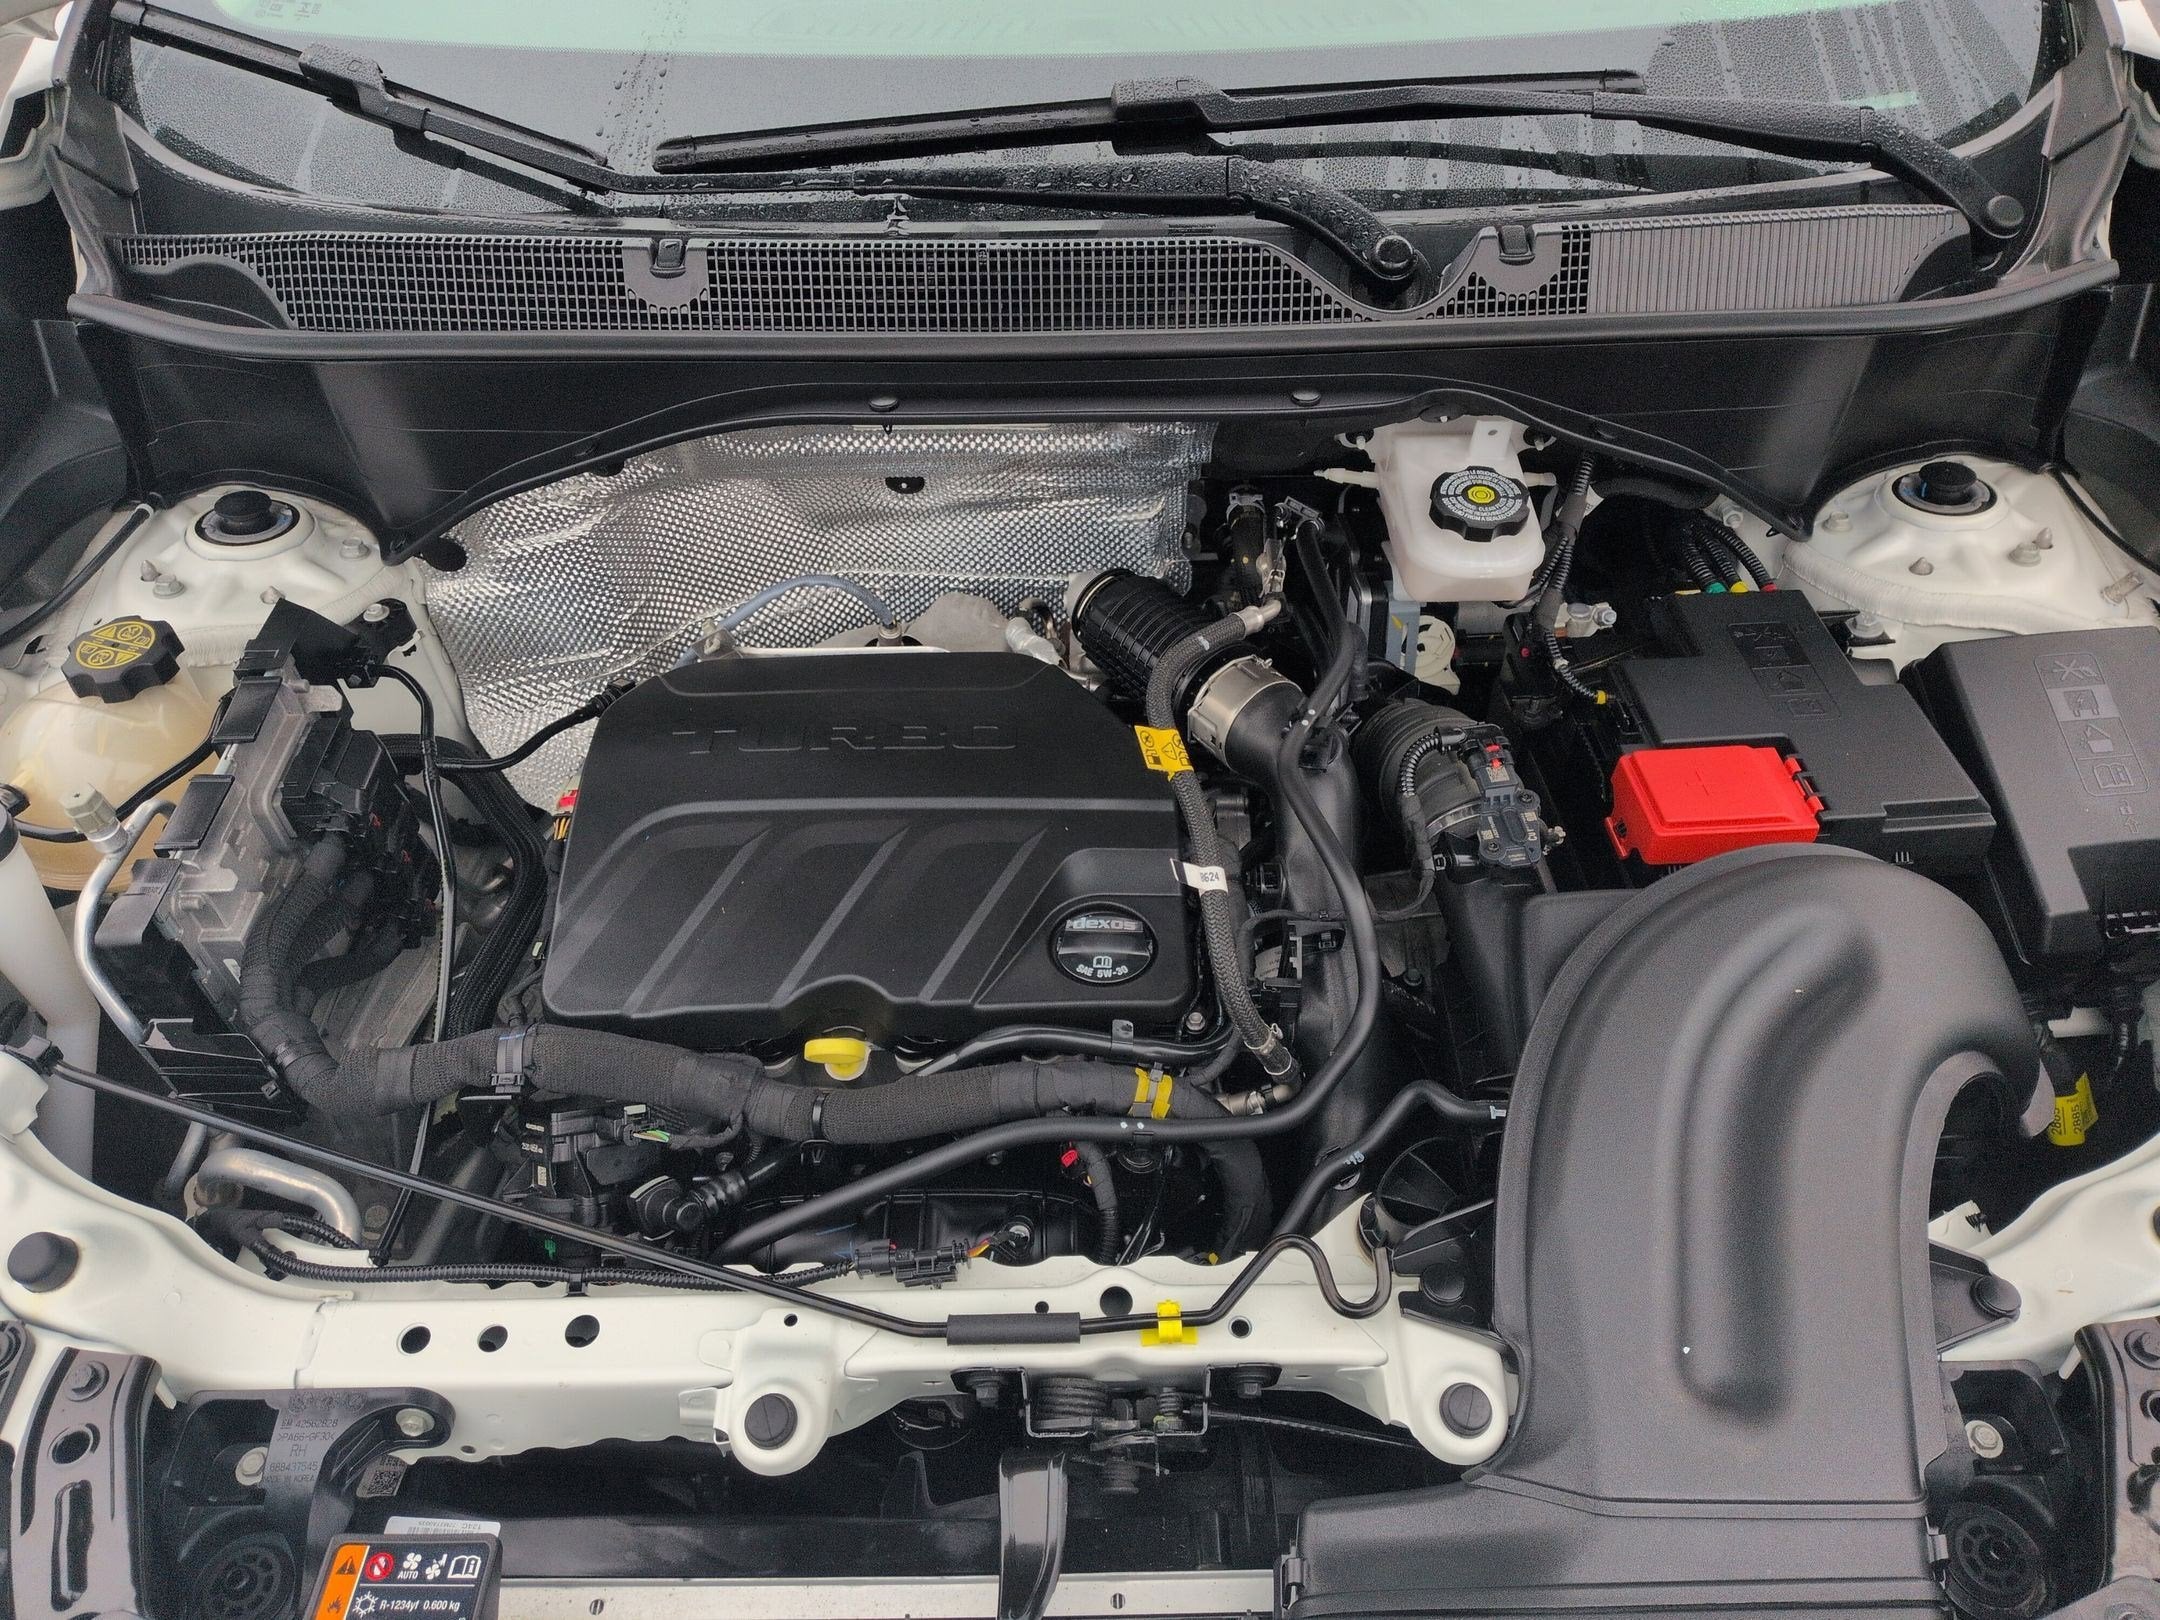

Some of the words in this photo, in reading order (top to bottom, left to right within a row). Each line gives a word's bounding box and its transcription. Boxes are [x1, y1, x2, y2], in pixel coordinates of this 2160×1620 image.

[672, 725, 1016, 755] TURBO
[1072, 917, 1137, 931] dexos
[1076, 964, 1094, 977] SAE
[1096, 964, 1129, 978] 5W-30
[290, 1443, 308, 1457] RH
[397, 1570, 419, 1579] AUTO
[379, 1600, 420, 1612] R-1234yf
[423, 1600, 448, 1610] 0.600
[449, 1600, 460, 1612] kg
